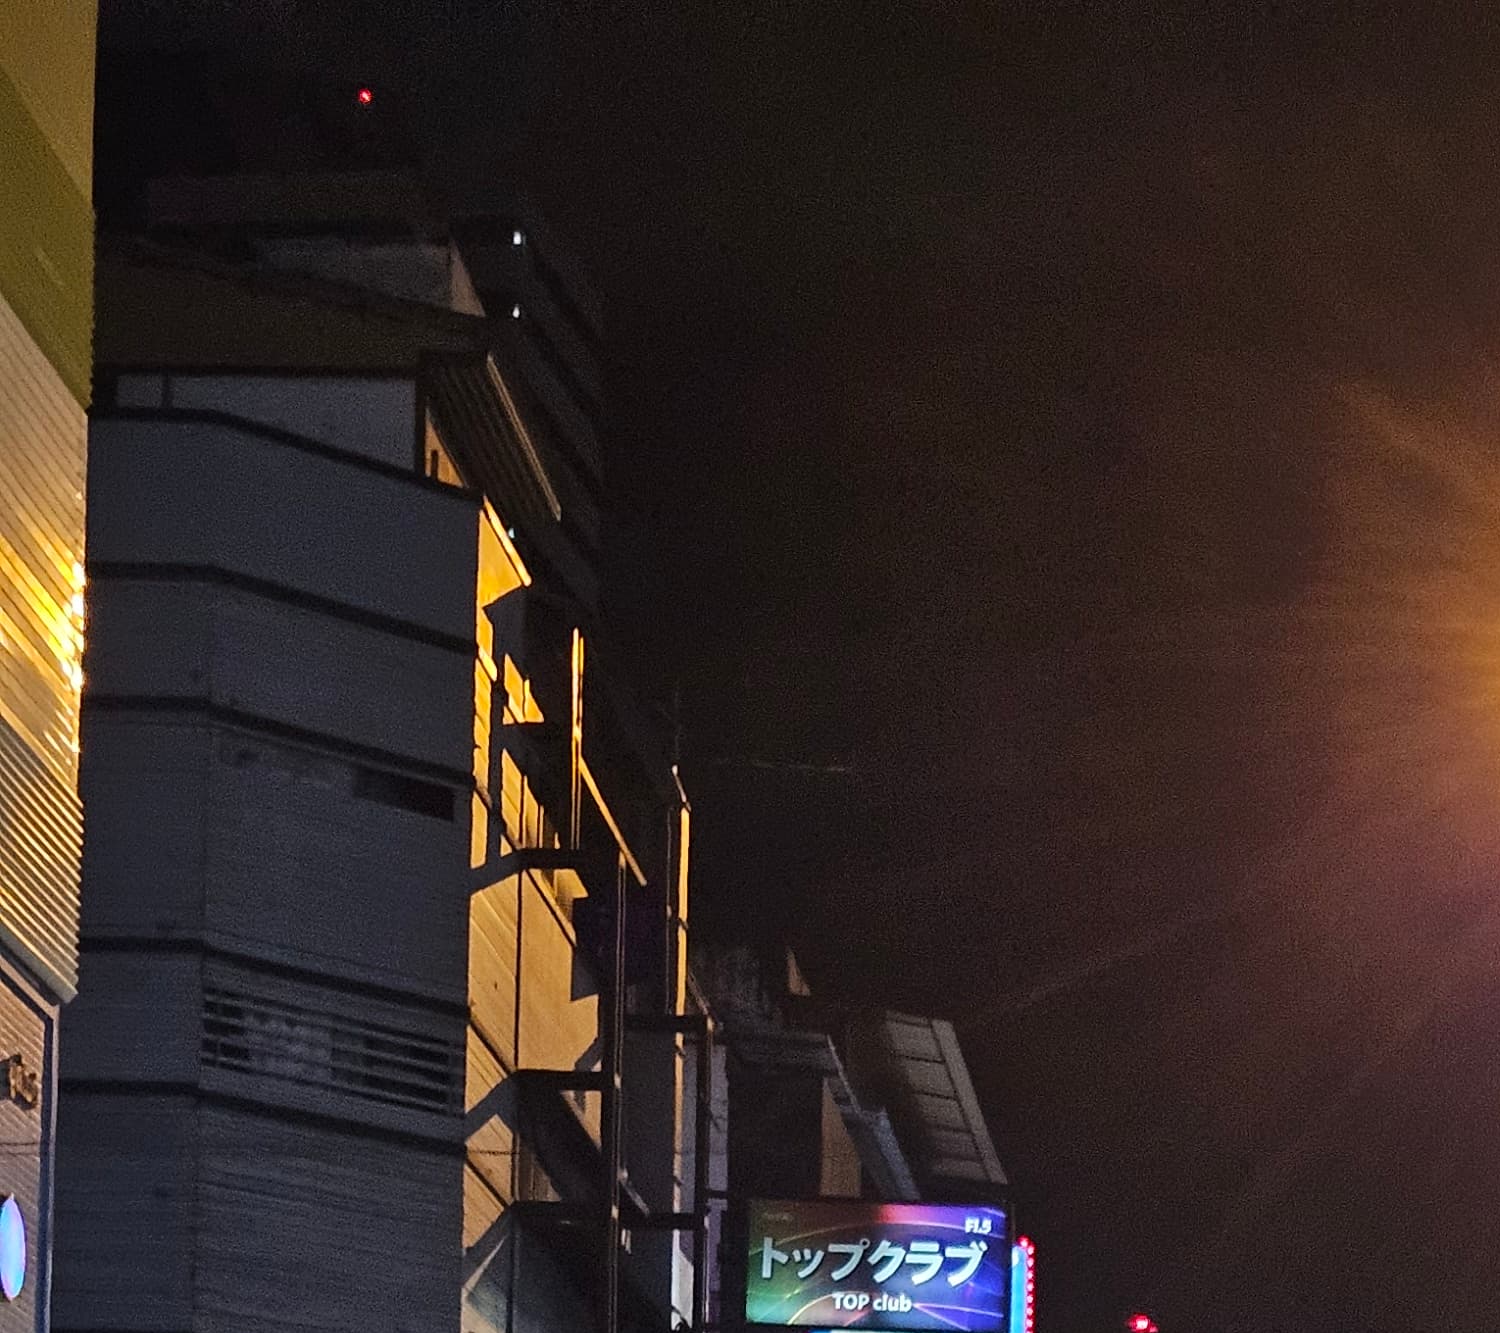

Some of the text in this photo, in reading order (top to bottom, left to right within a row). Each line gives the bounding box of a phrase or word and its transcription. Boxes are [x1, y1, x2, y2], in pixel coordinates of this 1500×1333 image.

[761, 1237, 988, 1288] トップクラブ
[832, 1293, 914, 1312] TOP club
